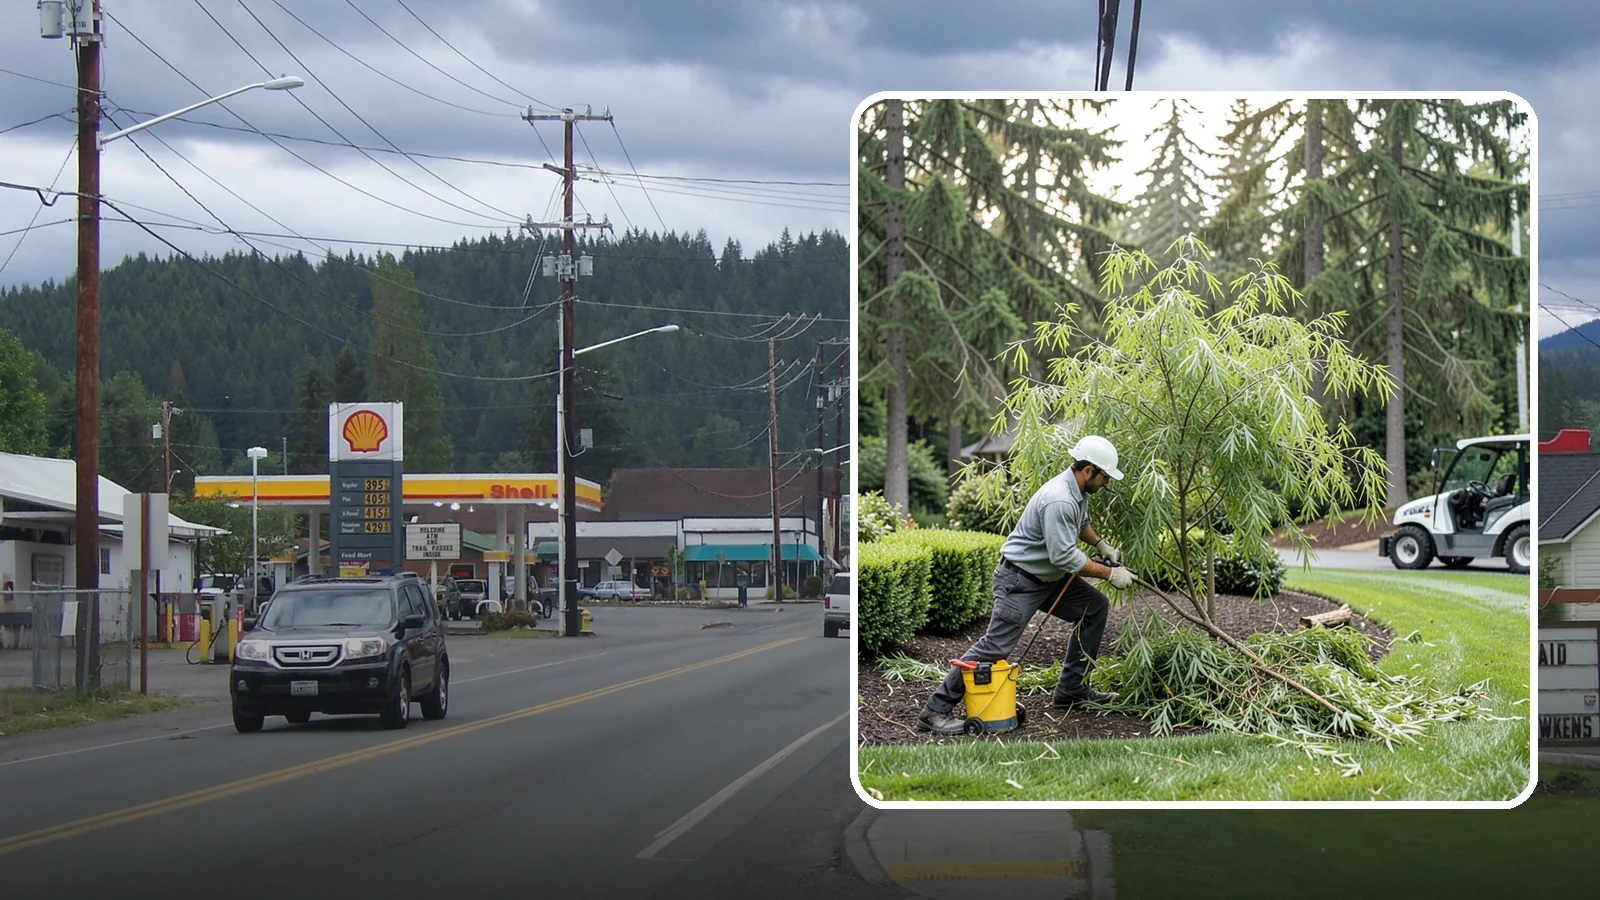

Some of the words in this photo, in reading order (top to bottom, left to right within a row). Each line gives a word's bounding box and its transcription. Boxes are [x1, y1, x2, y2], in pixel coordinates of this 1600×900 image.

[365, 480, 384, 490] 395
[489, 484, 547, 499] Shell
[365, 494, 384, 504] 405
[365, 508, 383, 518] 415
[365, 522, 384, 533] 429
[1539, 643, 1567, 665] AID
